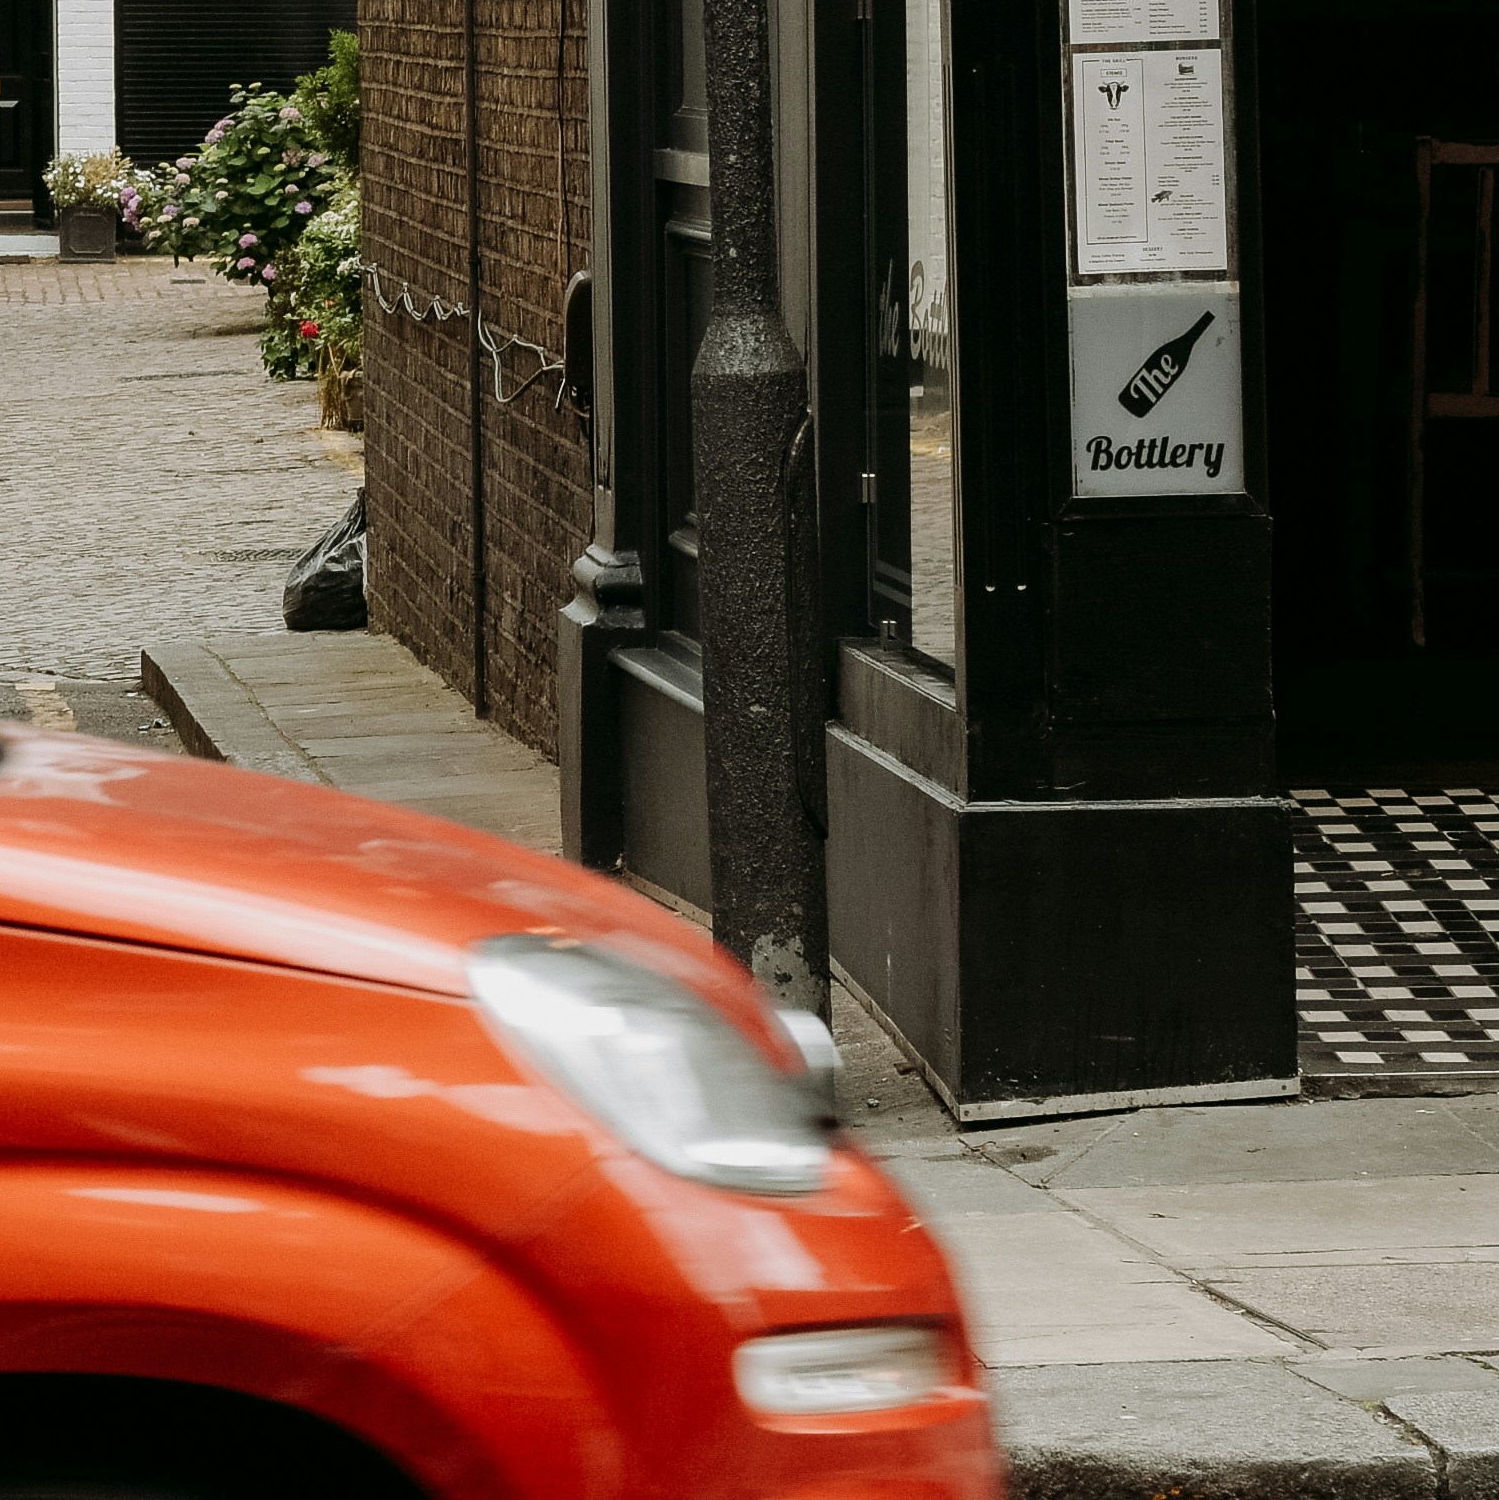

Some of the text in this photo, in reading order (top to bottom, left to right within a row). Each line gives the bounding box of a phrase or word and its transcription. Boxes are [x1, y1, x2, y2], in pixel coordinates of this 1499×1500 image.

[909, 260, 949, 370] Bottl
[1130, 354, 1179, 403] The
[1085, 435, 1225, 479] Bottlery
